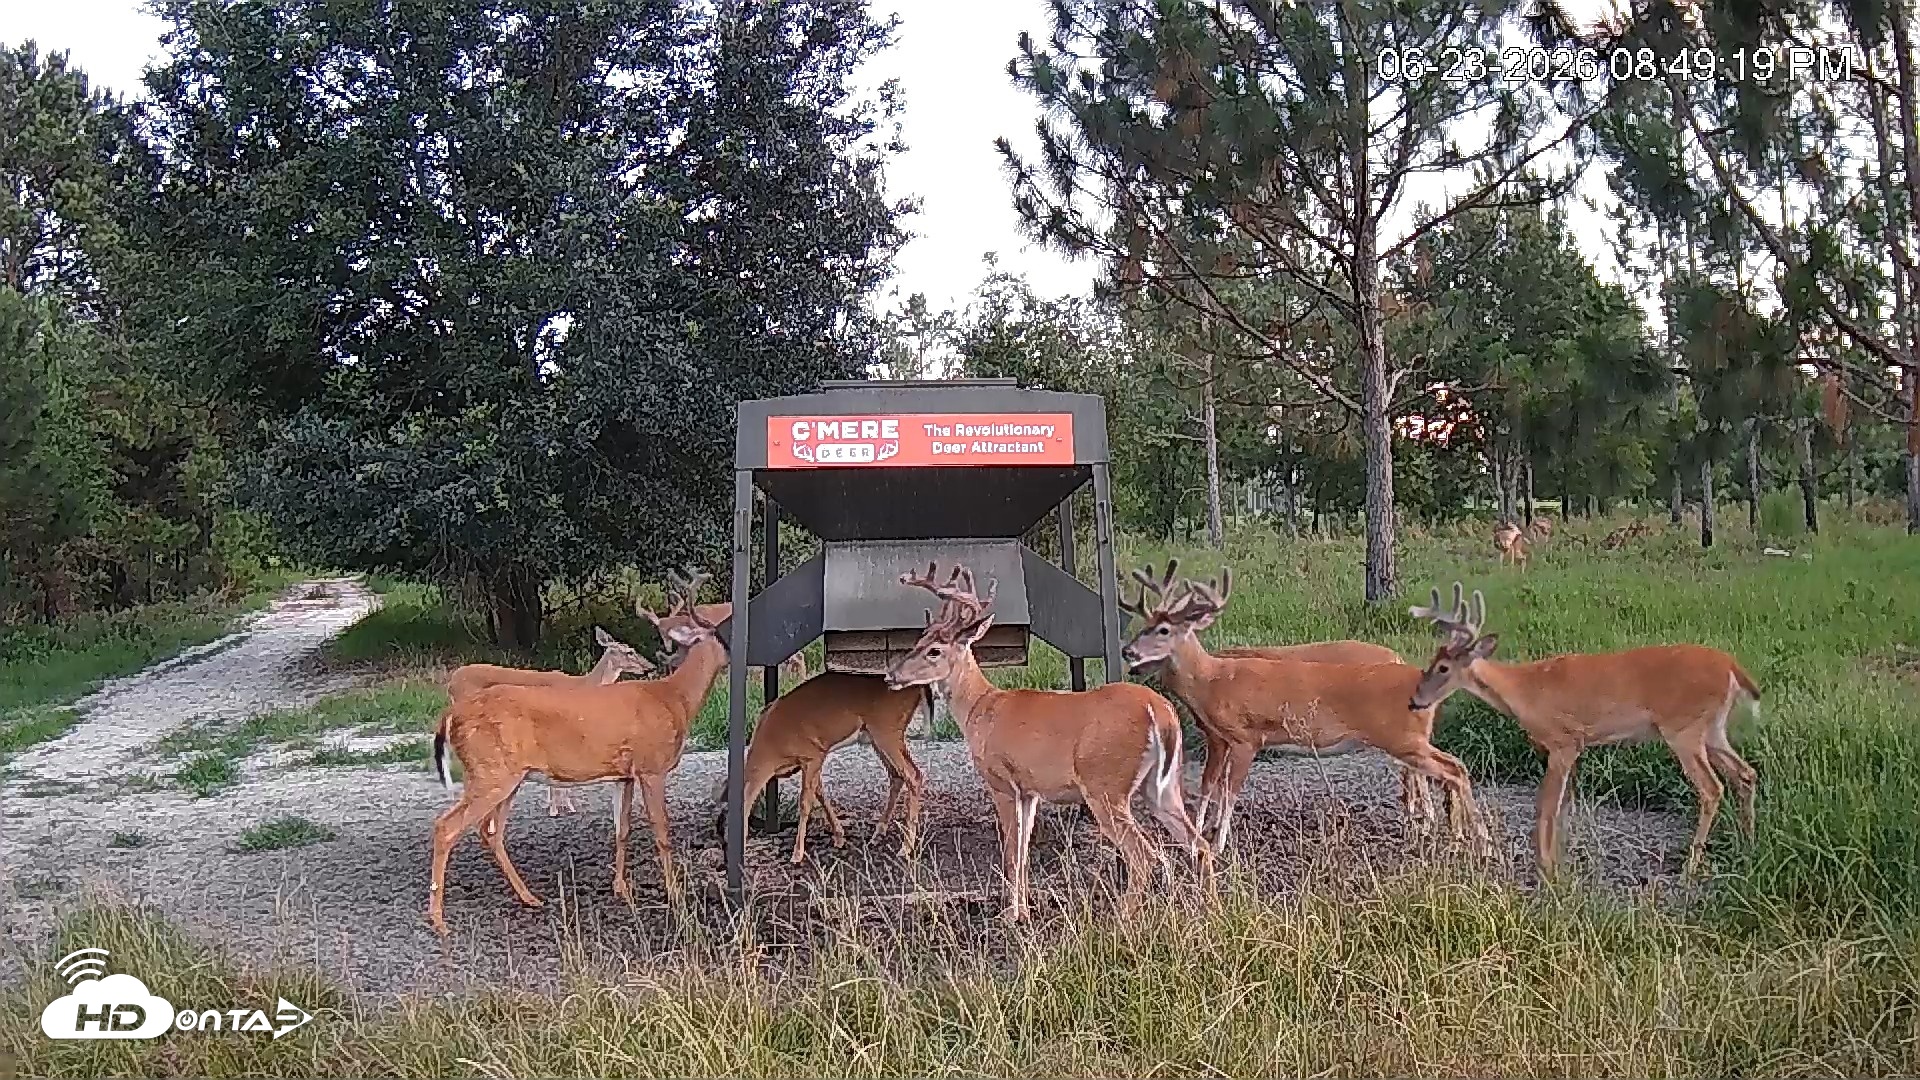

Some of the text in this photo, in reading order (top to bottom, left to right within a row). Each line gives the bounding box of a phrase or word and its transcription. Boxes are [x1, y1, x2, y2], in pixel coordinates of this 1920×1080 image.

[791, 419, 900, 440] C'MERE
[923, 423, 1055, 438] The Revolutionary
[821, 448, 871, 459] DEER
[931, 440, 1044, 455] Deer Attractant
